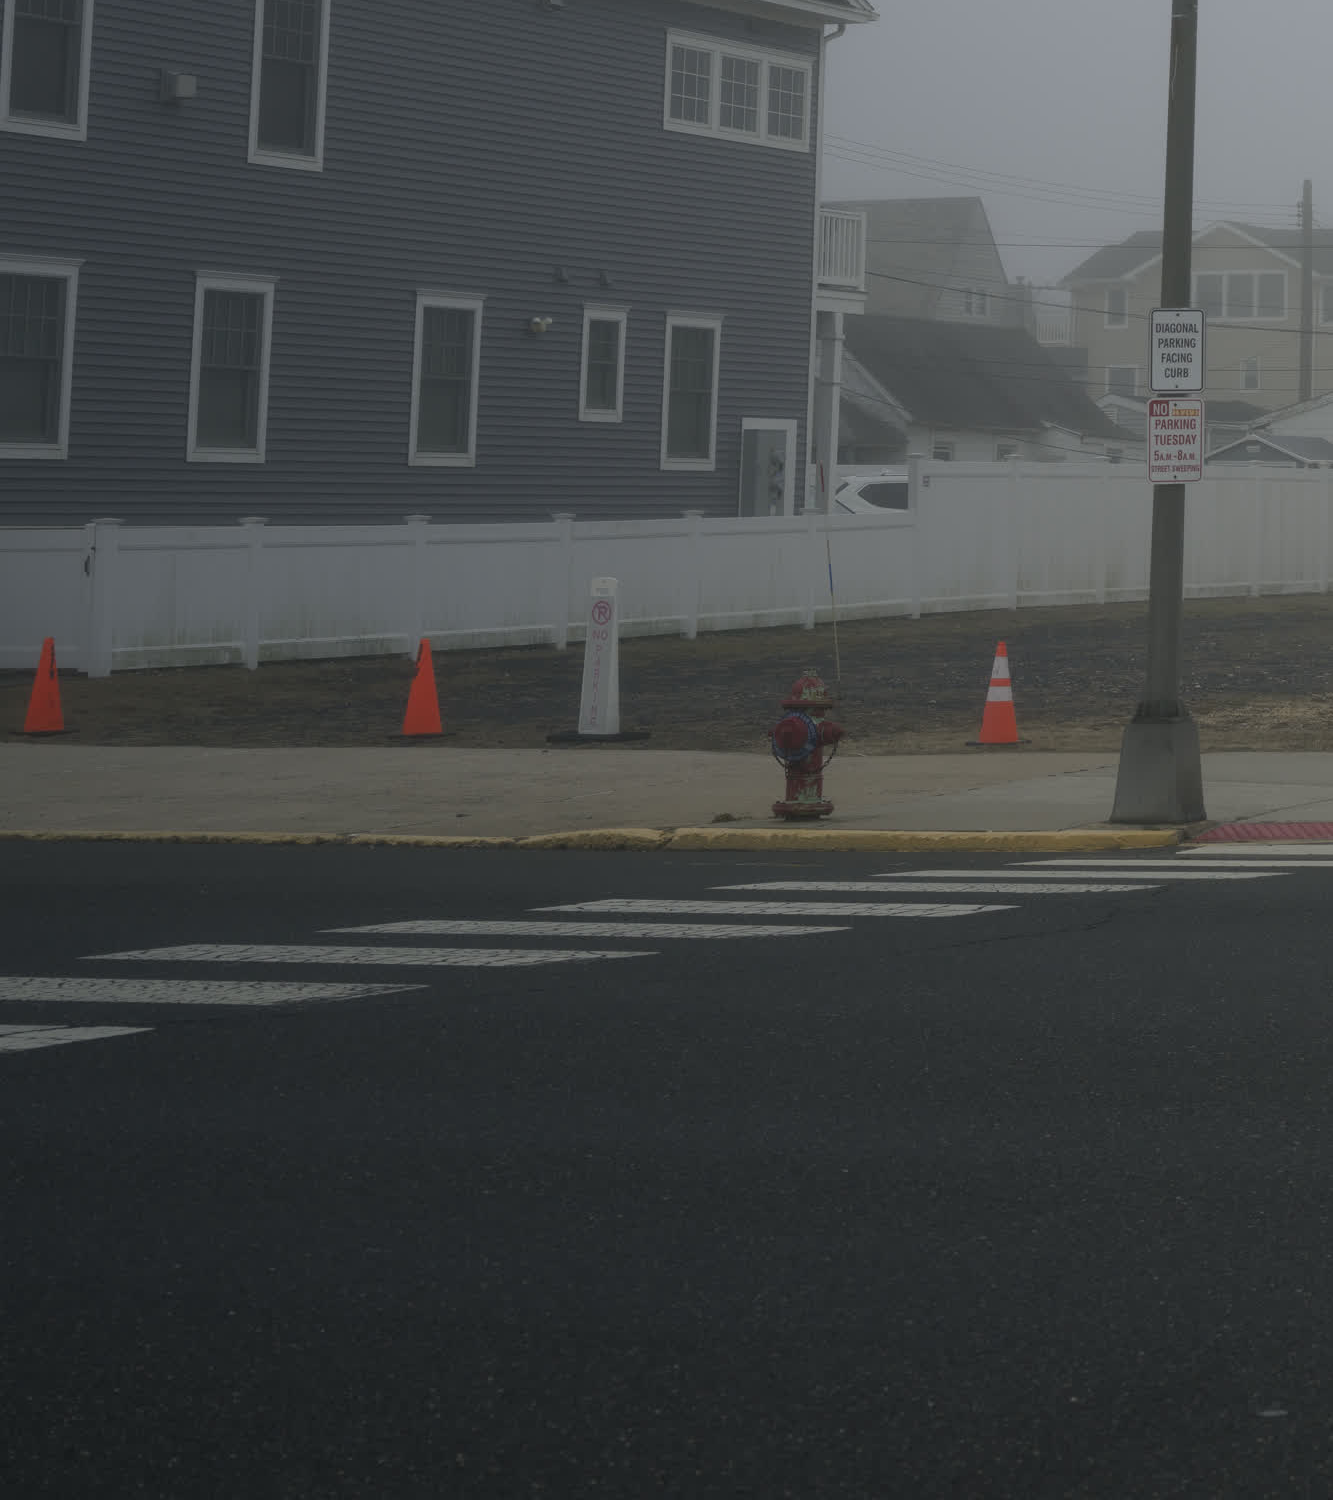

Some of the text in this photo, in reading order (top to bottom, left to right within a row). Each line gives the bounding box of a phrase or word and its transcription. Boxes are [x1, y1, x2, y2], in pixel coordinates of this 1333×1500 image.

[1155, 323, 1199, 333] DIAGONAL
[1157, 338, 1196, 348] PARKING
[1161, 353, 1192, 363] FACING
[1164, 368, 1189, 378] CURB
[1153, 403, 1168, 415] NO
[1154, 419, 1196, 430] PARKING
[1154, 434, 1197, 445] TUESDAY
[592, 629, 608, 641] NO
